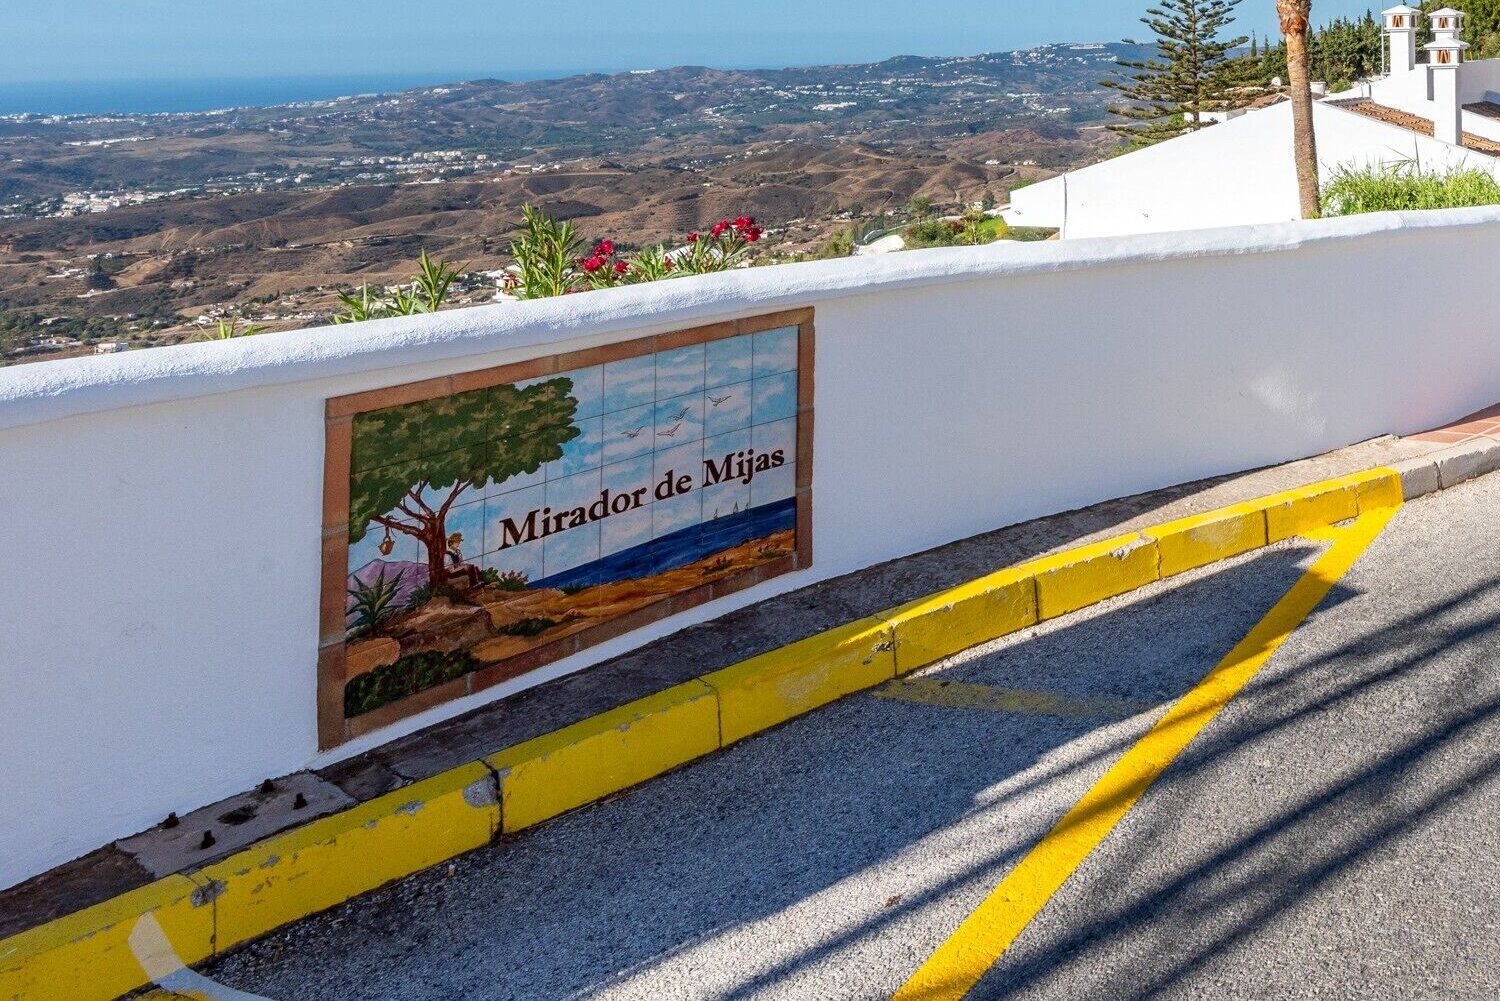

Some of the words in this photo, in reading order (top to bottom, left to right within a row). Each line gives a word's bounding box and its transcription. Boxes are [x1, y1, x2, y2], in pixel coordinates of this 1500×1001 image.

[498, 486, 648, 551] Mirador
[654, 470, 692, 500] de
[702, 448, 785, 487] Mijas
